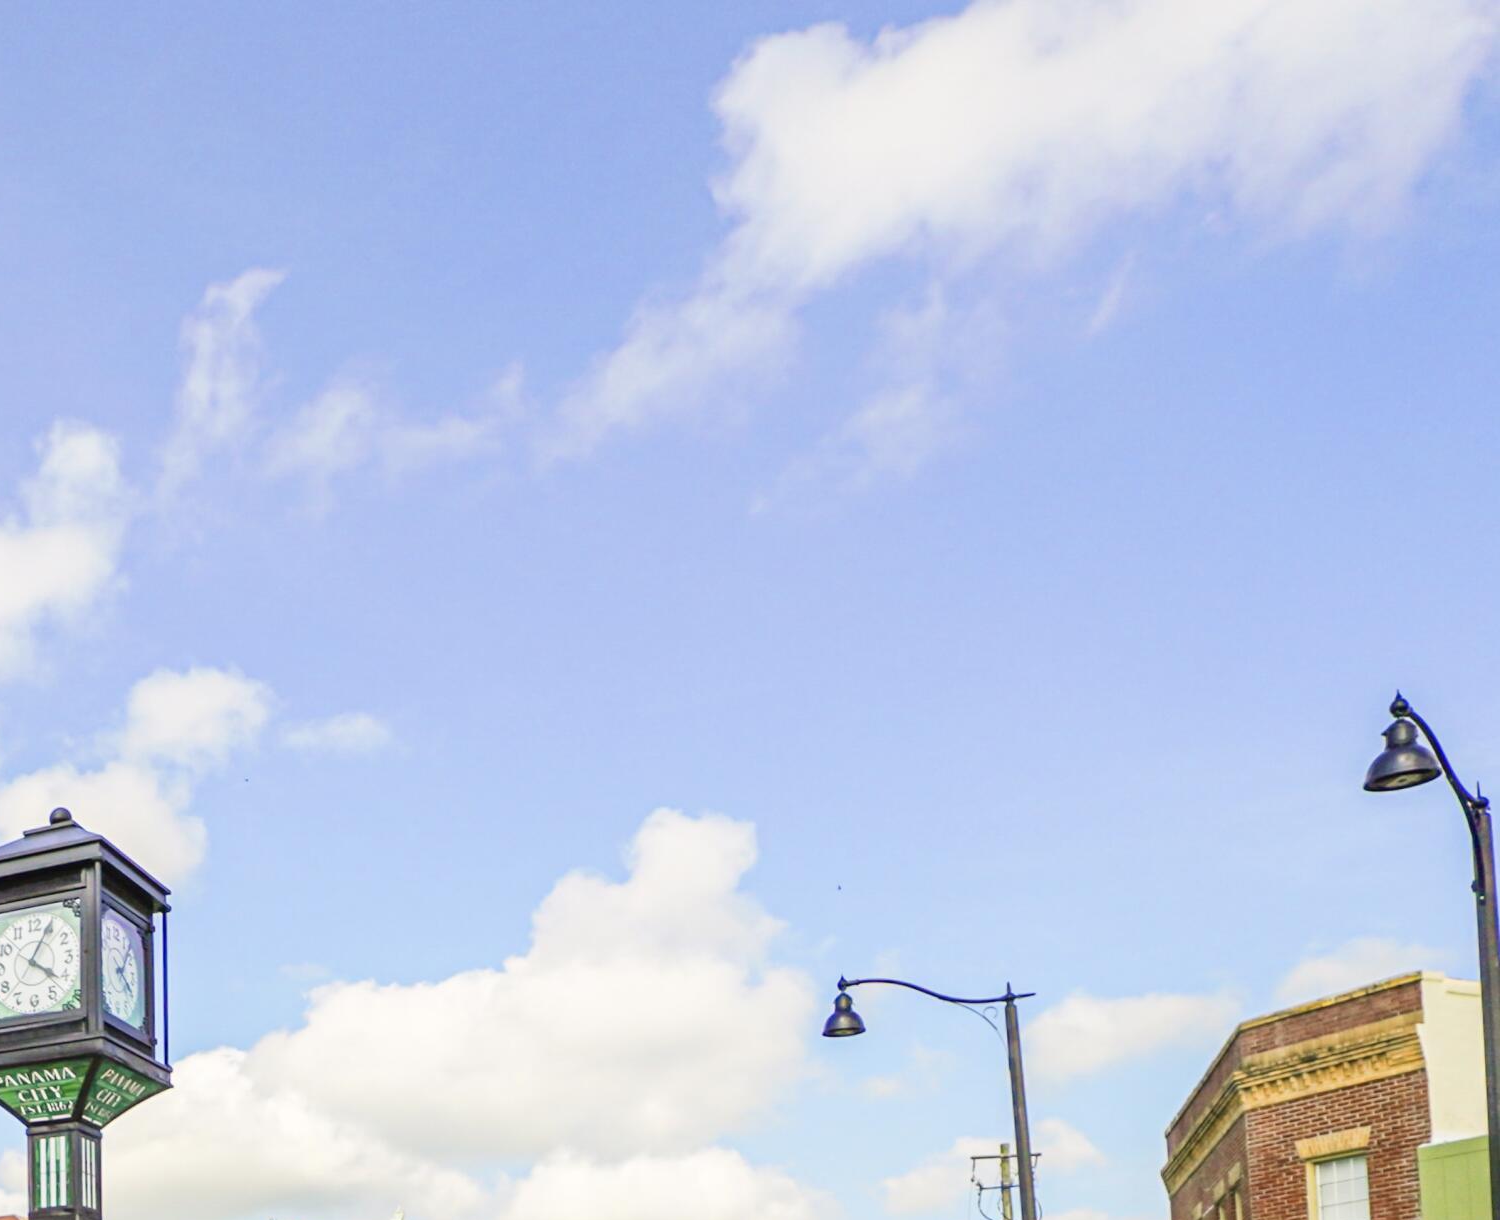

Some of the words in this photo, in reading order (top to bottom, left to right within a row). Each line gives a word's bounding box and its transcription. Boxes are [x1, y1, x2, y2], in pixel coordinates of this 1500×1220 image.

[28, 918, 42, 933] 12
[13, 927, 23, 940] 11
[60, 932, 69, 945] 2
[0, 943, 13, 957] 10
[64, 950, 74, 964] 3
[60, 968, 70, 982] 4
[0, 981, 10, 994] 8
[48, 985, 58, 1001] 5
[13, 992, 22, 1005] 7
[29, 994, 39, 1007] 6
[18, 1085, 63, 1103] CITY
[96, 1088, 122, 1107] CITY
